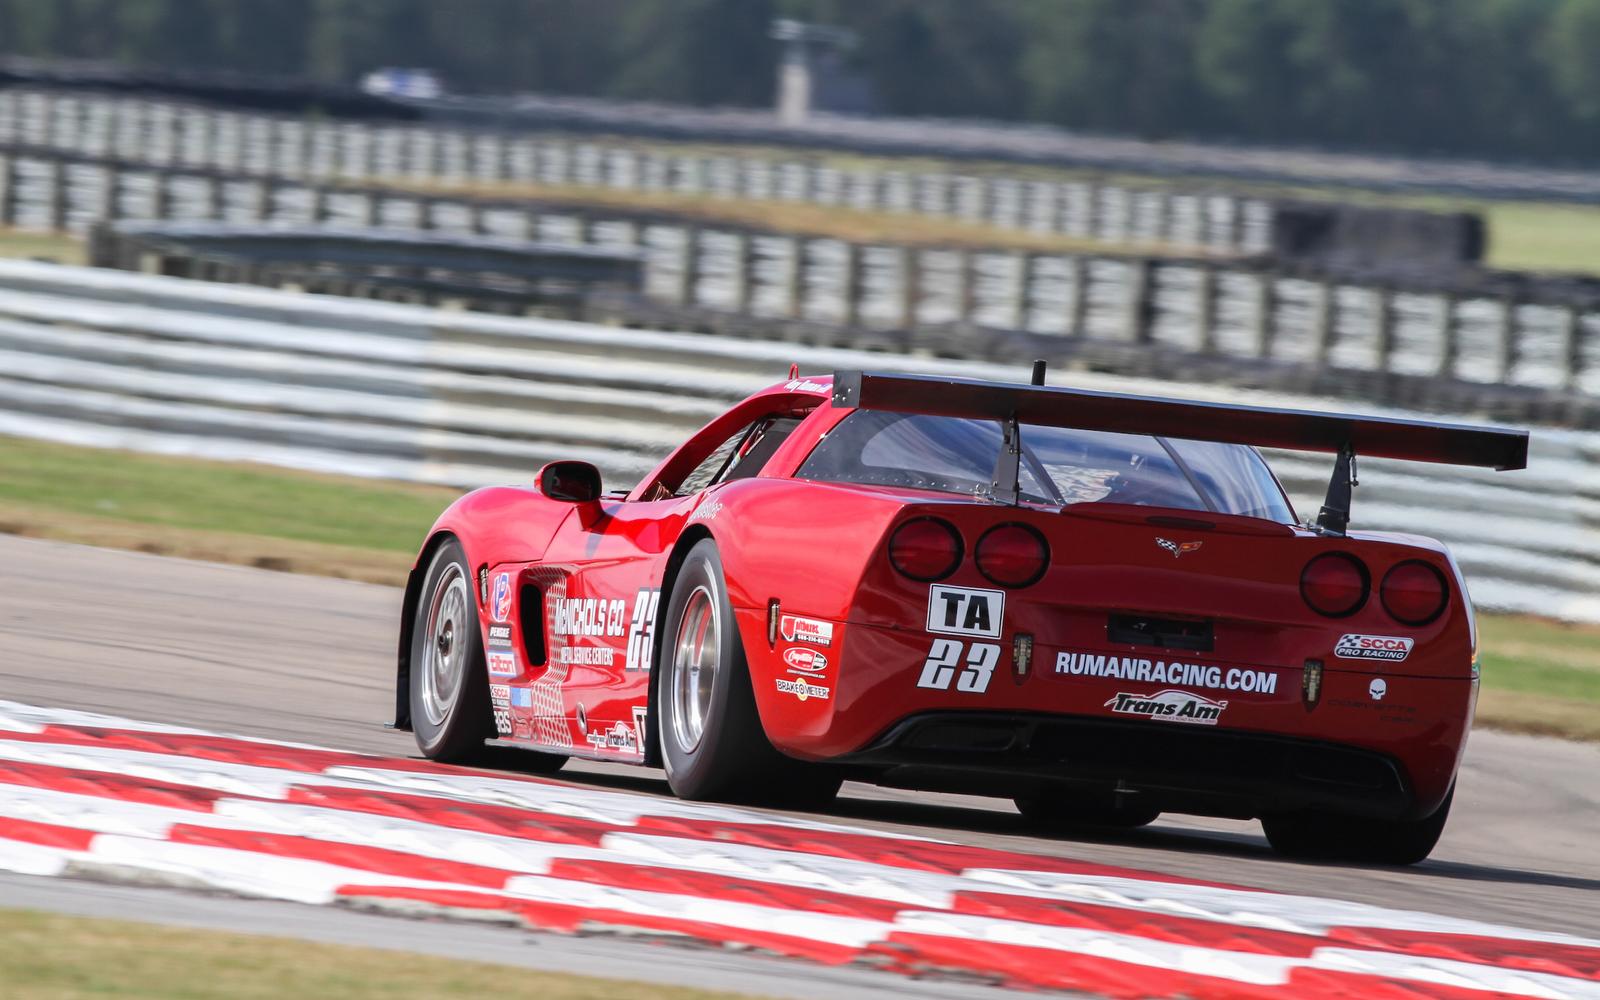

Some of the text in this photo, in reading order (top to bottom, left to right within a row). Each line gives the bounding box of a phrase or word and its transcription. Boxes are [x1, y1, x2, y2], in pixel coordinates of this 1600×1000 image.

[607, 599, 625, 636] CO.
[941, 592, 991, 631] TA
[625, 587, 660, 671] 23
[1360, 638, 1407, 651] SCCA
[574, 647, 593, 665] SERVICE
[592, 647, 614, 666] CENTERS
[917, 638, 1001, 693] 23
[1337, 648, 1405, 659] PRO RACING
[1055, 652, 1278, 694] RUMANRACING.COM
[1112, 692, 1176, 716] Trans
[1177, 700, 1220, 720] Am
[606, 728, 624, 746] Trans
